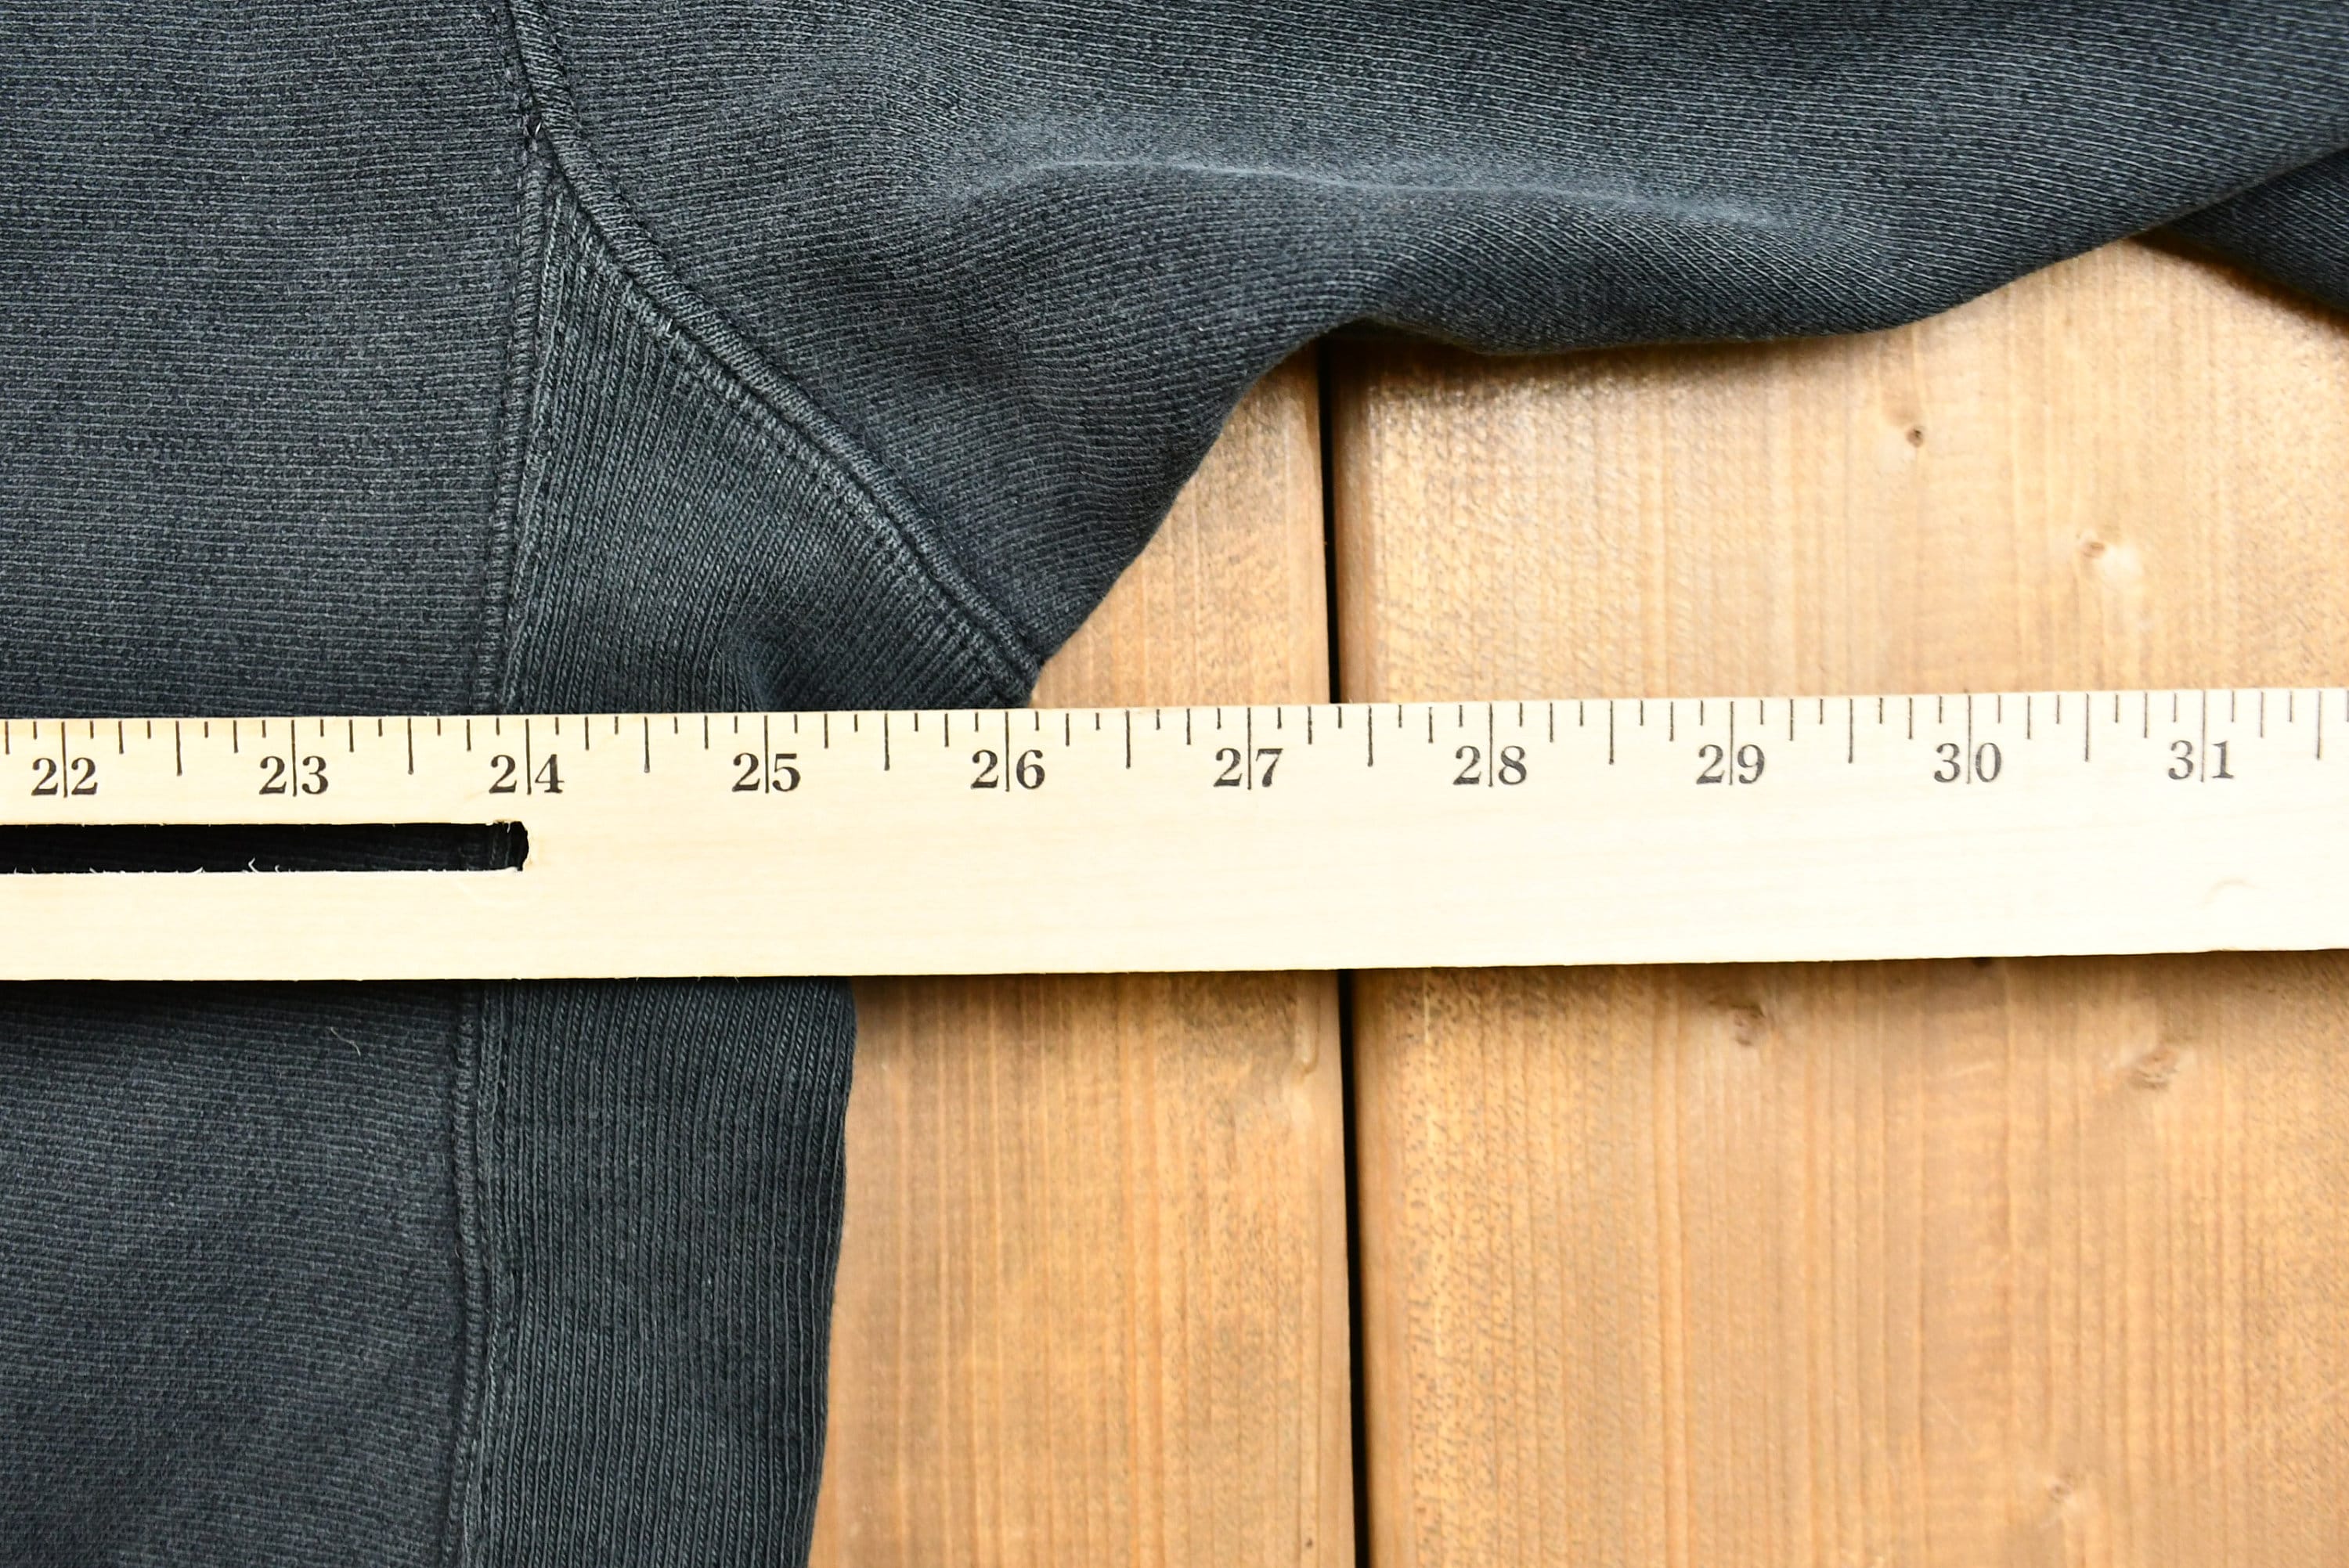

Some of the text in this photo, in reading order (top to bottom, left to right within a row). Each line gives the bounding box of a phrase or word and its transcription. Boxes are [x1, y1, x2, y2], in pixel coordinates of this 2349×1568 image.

[31, 741, 2234, 796] 22 23 24 25 26 27 28 29 30 31
